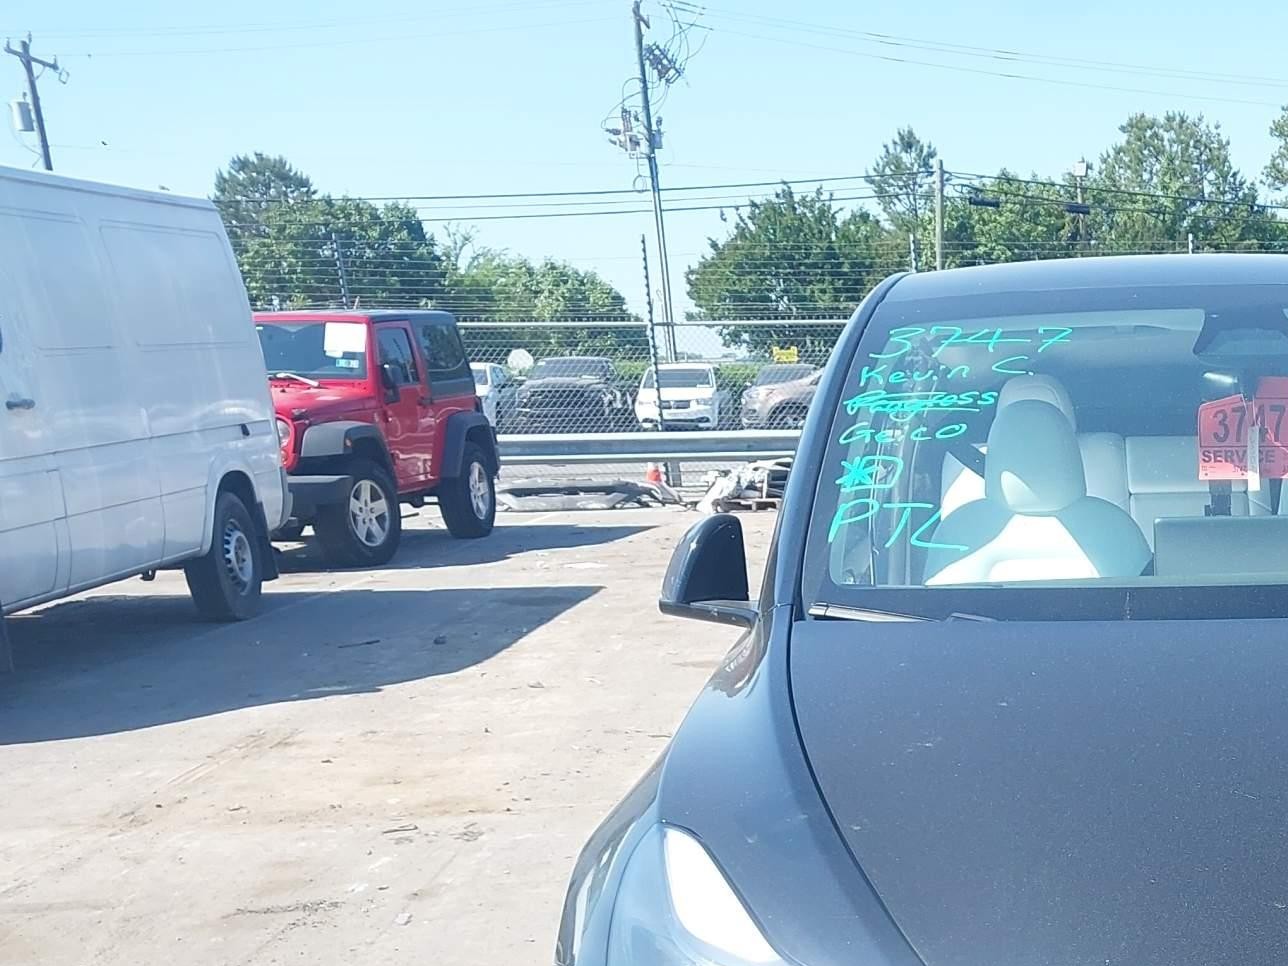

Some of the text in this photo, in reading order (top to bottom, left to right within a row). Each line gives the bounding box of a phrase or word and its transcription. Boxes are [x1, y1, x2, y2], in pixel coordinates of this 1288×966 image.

[869, 326, 1073, 358] 3747
[859, 364, 970, 387] Kevin
[1201, 449, 1276, 464] SERVE
[827, 498, 970, 551] PTL
